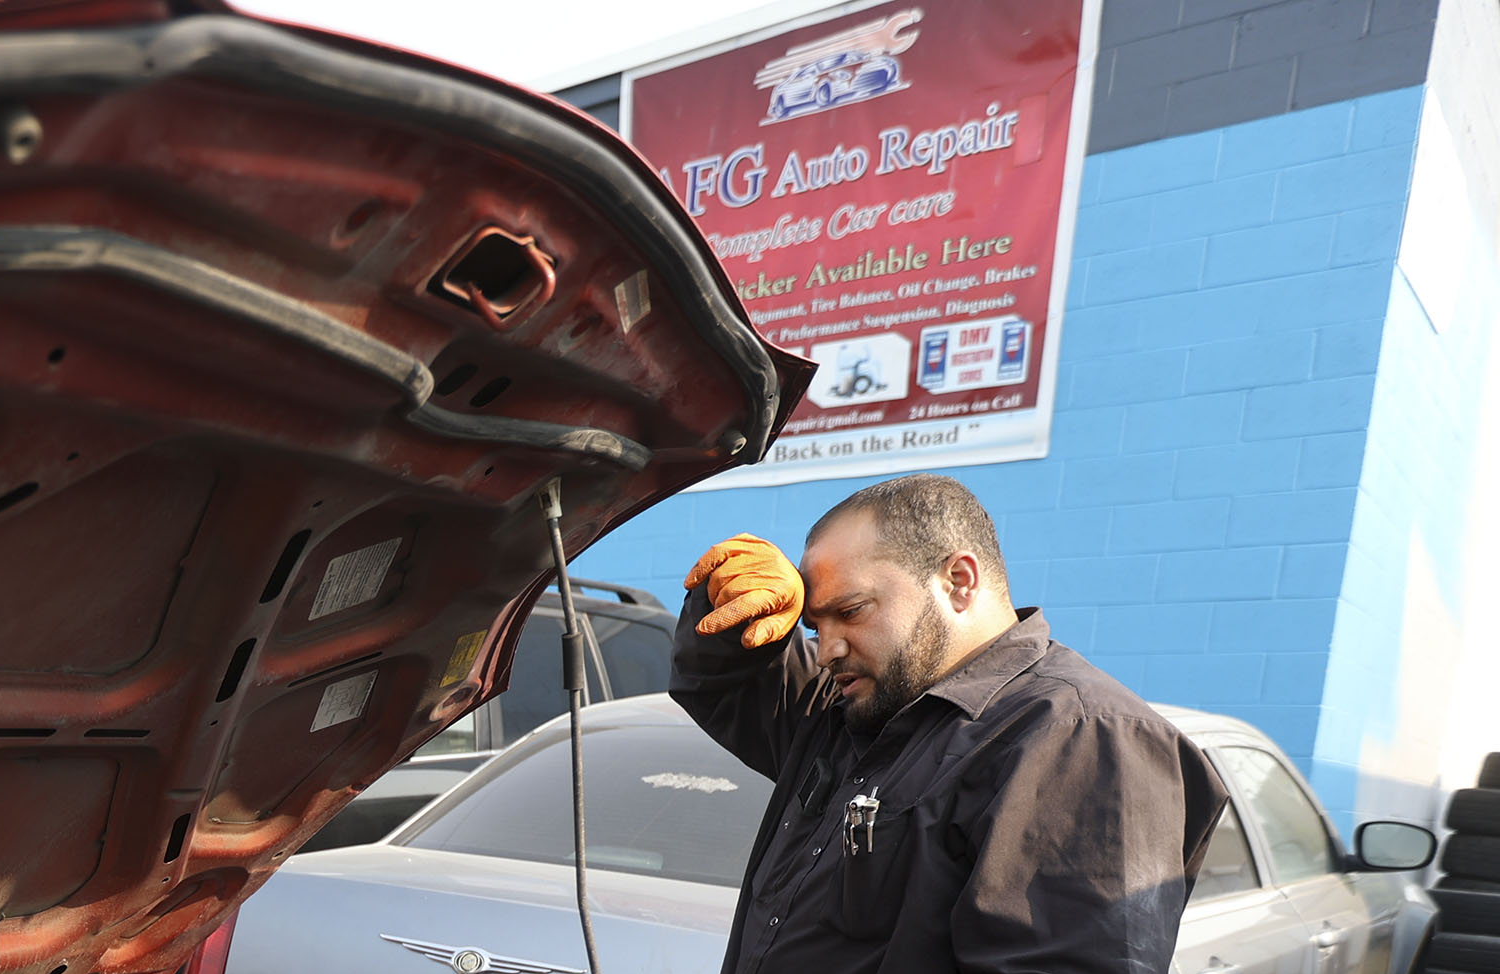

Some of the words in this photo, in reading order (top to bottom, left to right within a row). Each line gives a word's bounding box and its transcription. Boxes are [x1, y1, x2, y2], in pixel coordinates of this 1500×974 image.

[660, 143, 768, 216] FG
[771, 144, 869, 198] Auto
[875, 101, 1019, 175] Repair
[828, 203, 887, 240] Car
[888, 190, 955, 226] care
[738, 271, 797, 299] icker
[805, 243, 929, 288] Available
[940, 234, 1014, 266] Here
[984, 264, 1038, 285] Brakes
[959, 326, 991, 347] DMV
[775, 441, 821, 461] Back
[829, 440, 853, 456] on
[861, 434, 894, 453] the
[902, 425, 959, 448] Road
